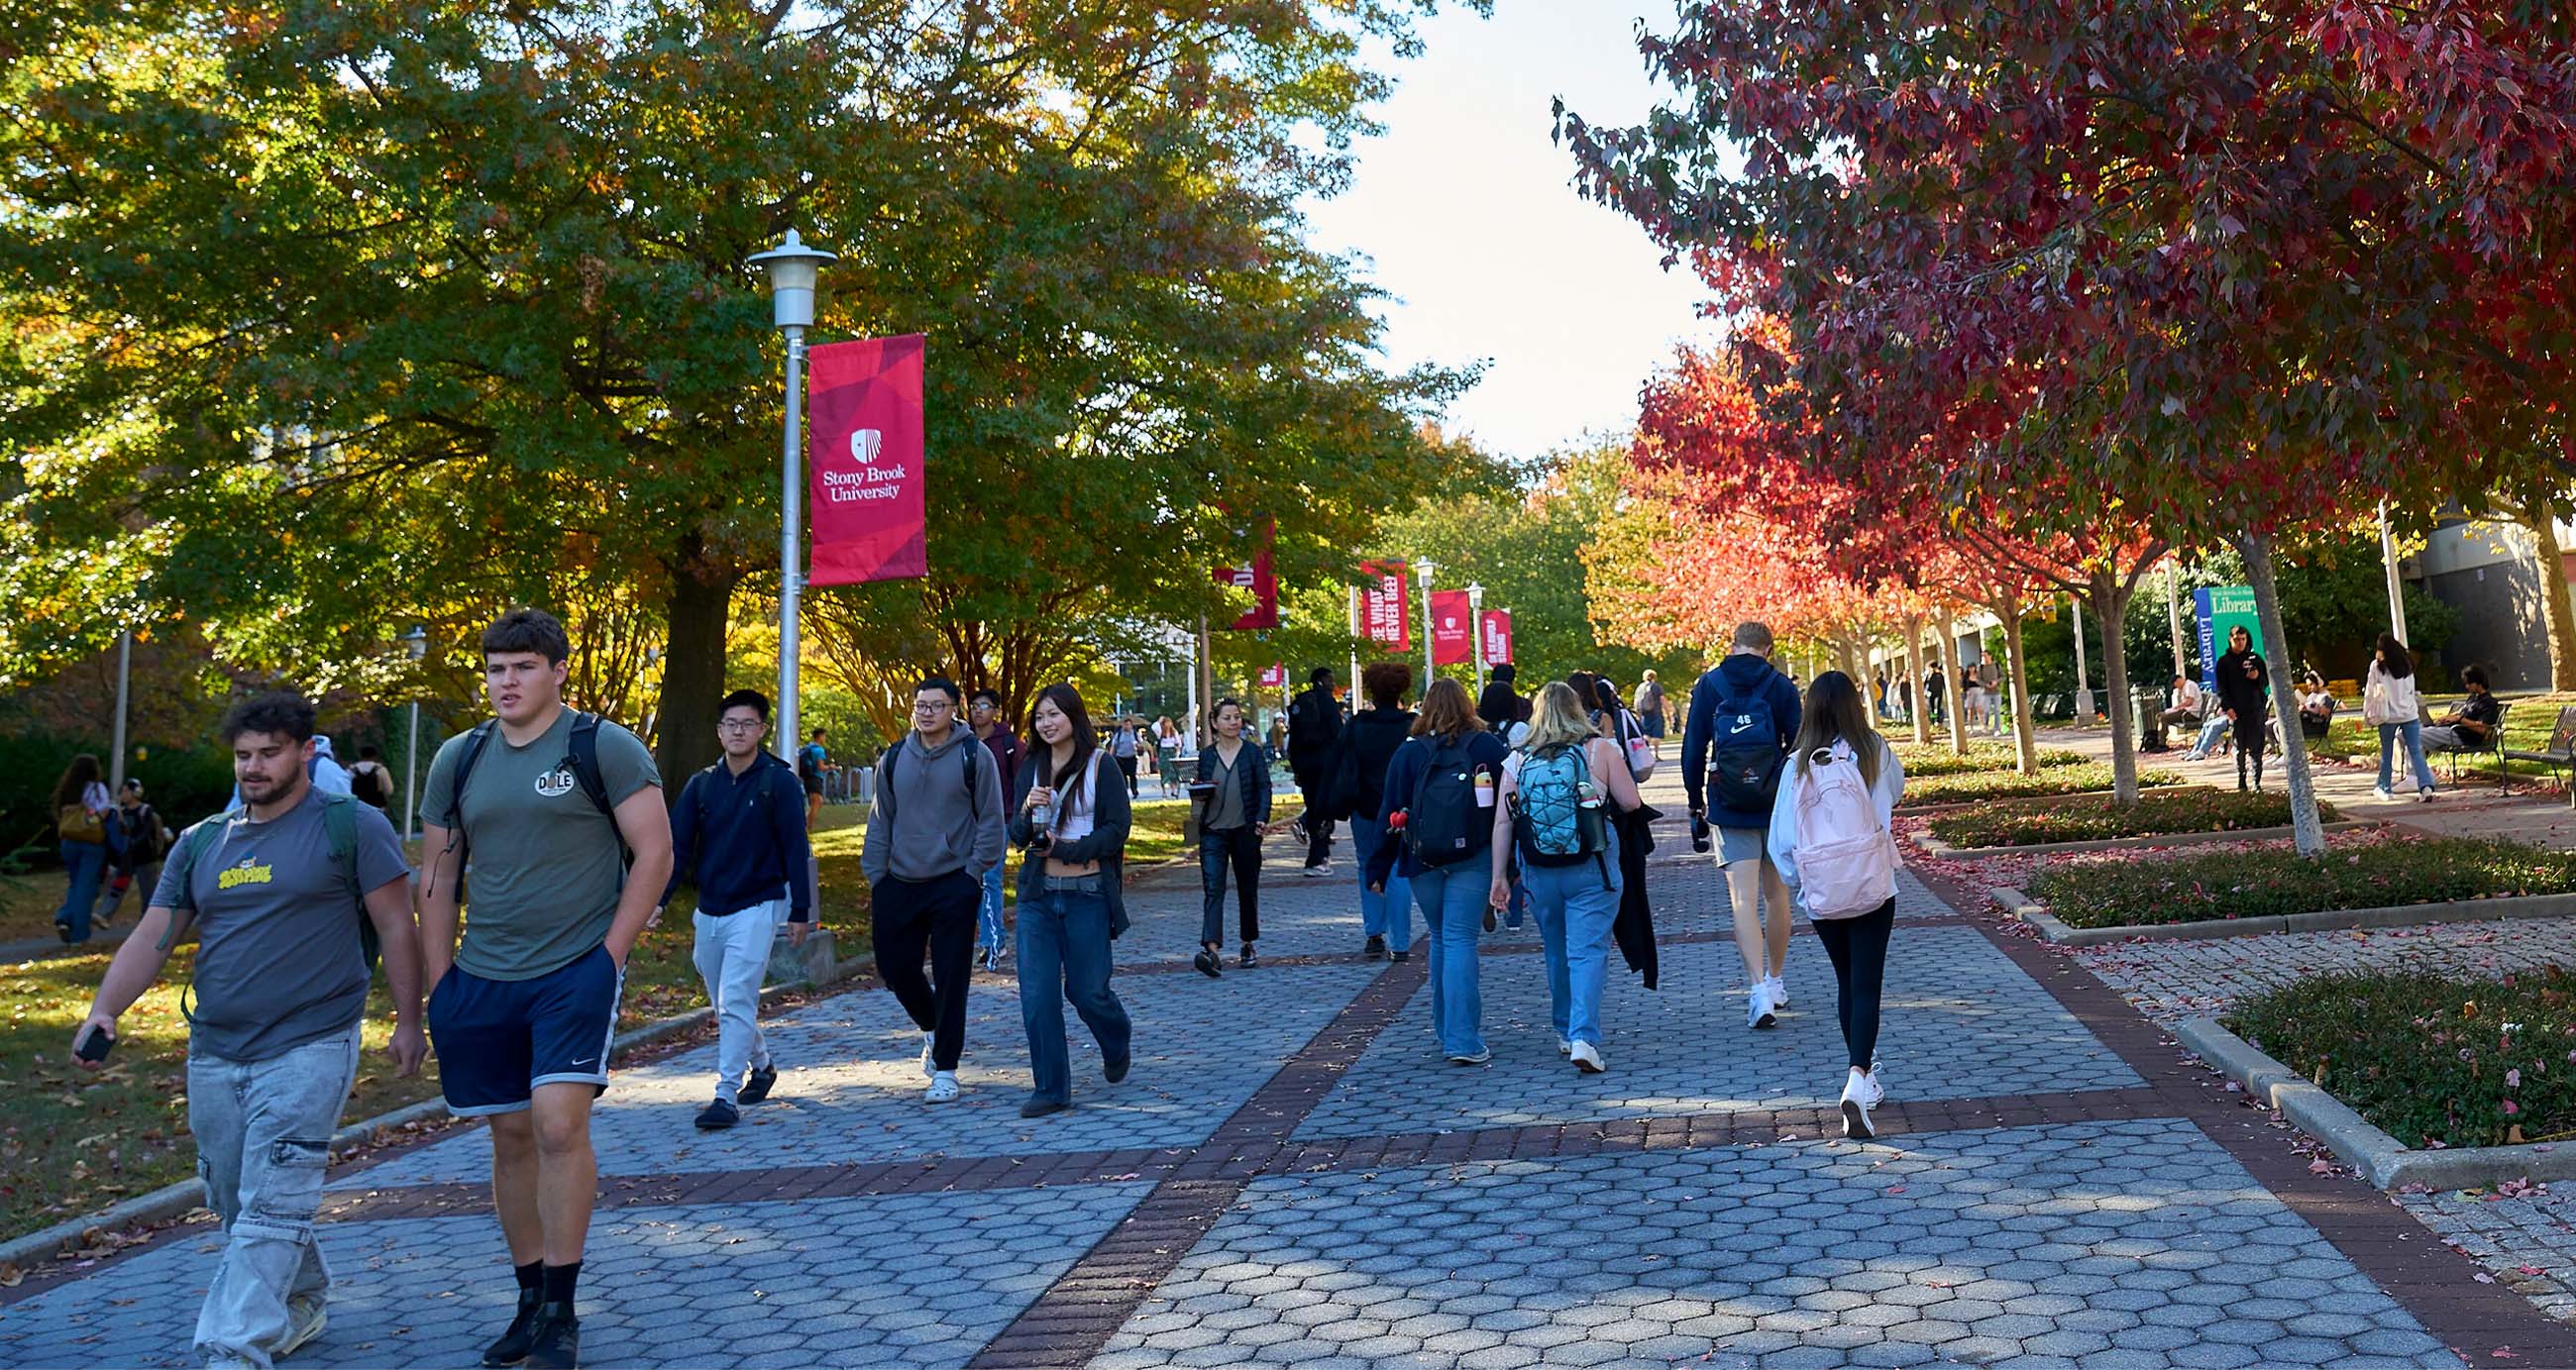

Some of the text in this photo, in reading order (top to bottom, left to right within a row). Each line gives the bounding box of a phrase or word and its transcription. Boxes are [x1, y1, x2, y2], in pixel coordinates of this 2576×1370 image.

[823, 463, 906, 486] Stony Brook
[830, 482, 901, 502] University
[1385, 603, 1401, 642] NEVER
[2200, 616, 2215, 674] Library
